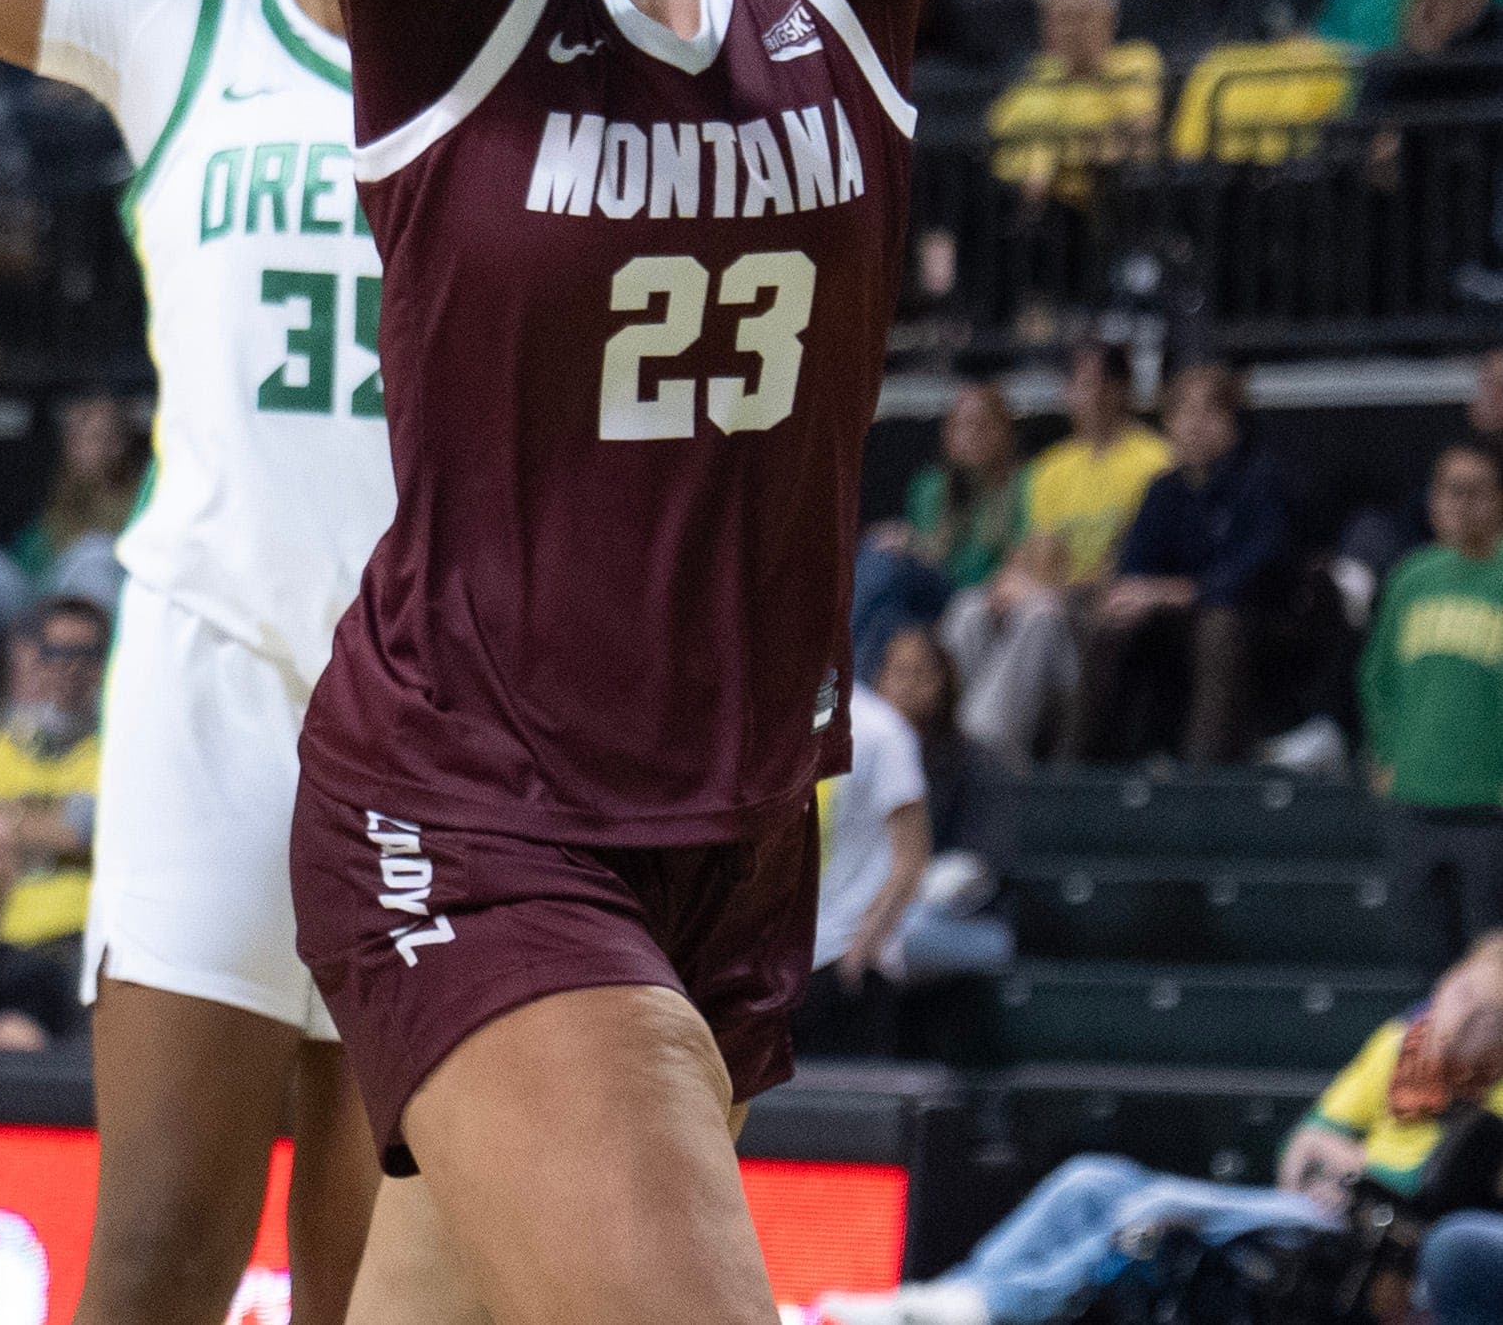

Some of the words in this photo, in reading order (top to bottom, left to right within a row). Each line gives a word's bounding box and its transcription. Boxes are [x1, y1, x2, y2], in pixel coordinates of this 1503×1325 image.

[200, 143, 374, 244] ORE
[526, 98, 865, 219] MONTANA
[599, 250, 817, 441] 23
